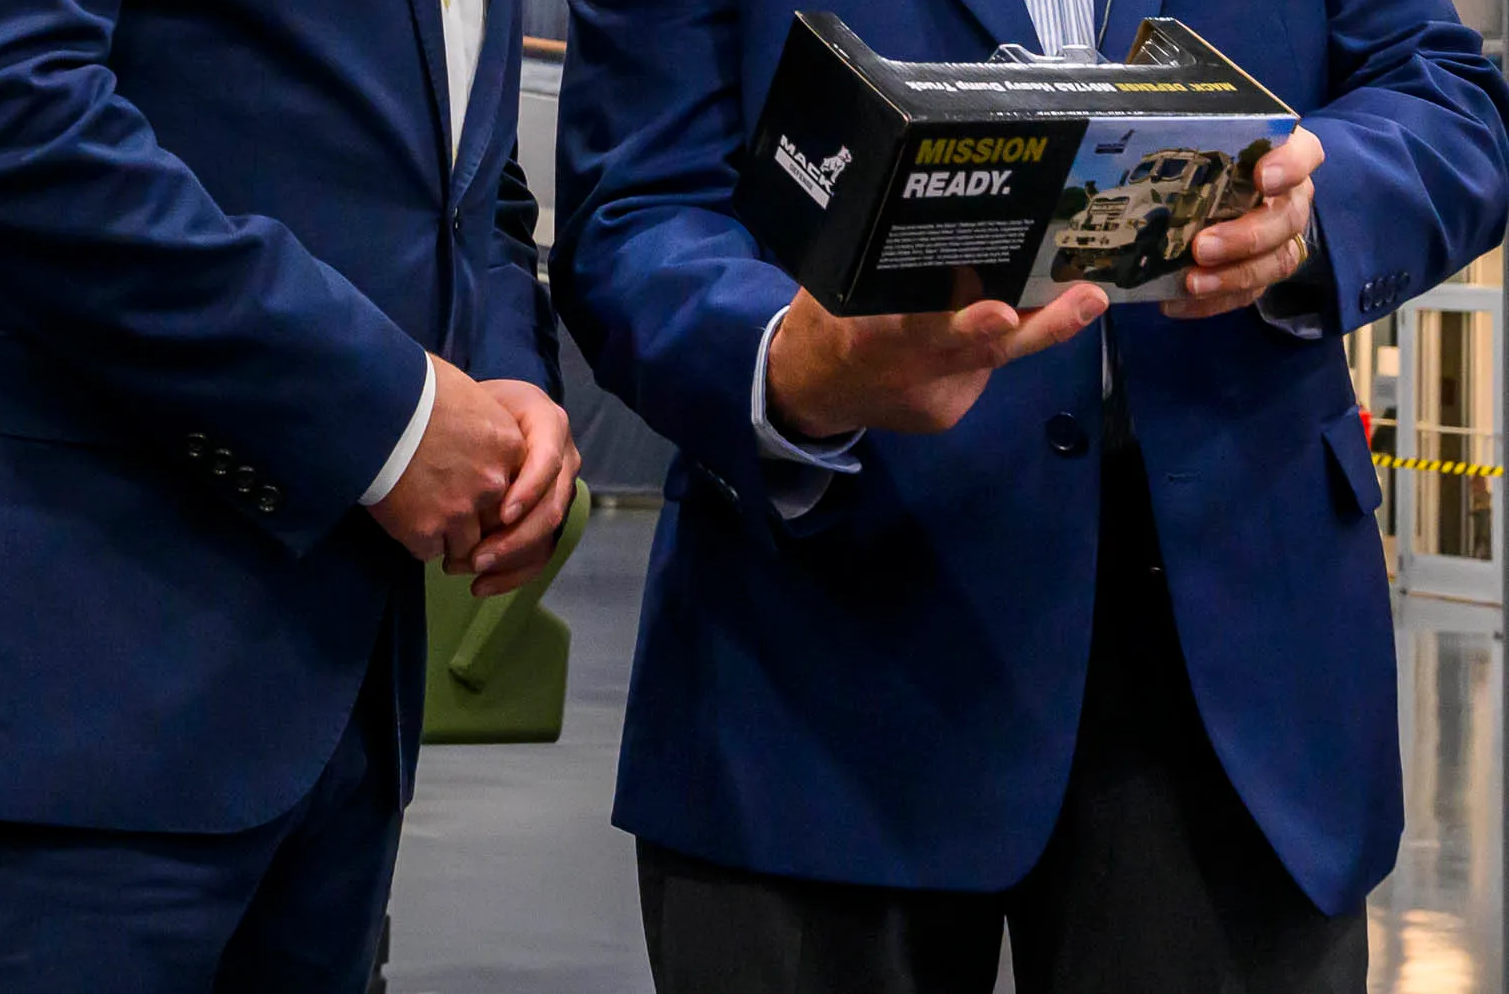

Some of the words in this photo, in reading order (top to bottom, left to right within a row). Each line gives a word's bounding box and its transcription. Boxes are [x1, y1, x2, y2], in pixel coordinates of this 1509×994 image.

[780, 133, 834, 195] MACK
[915, 136, 1048, 165] MISSION
[902, 169, 1012, 199] READY.
